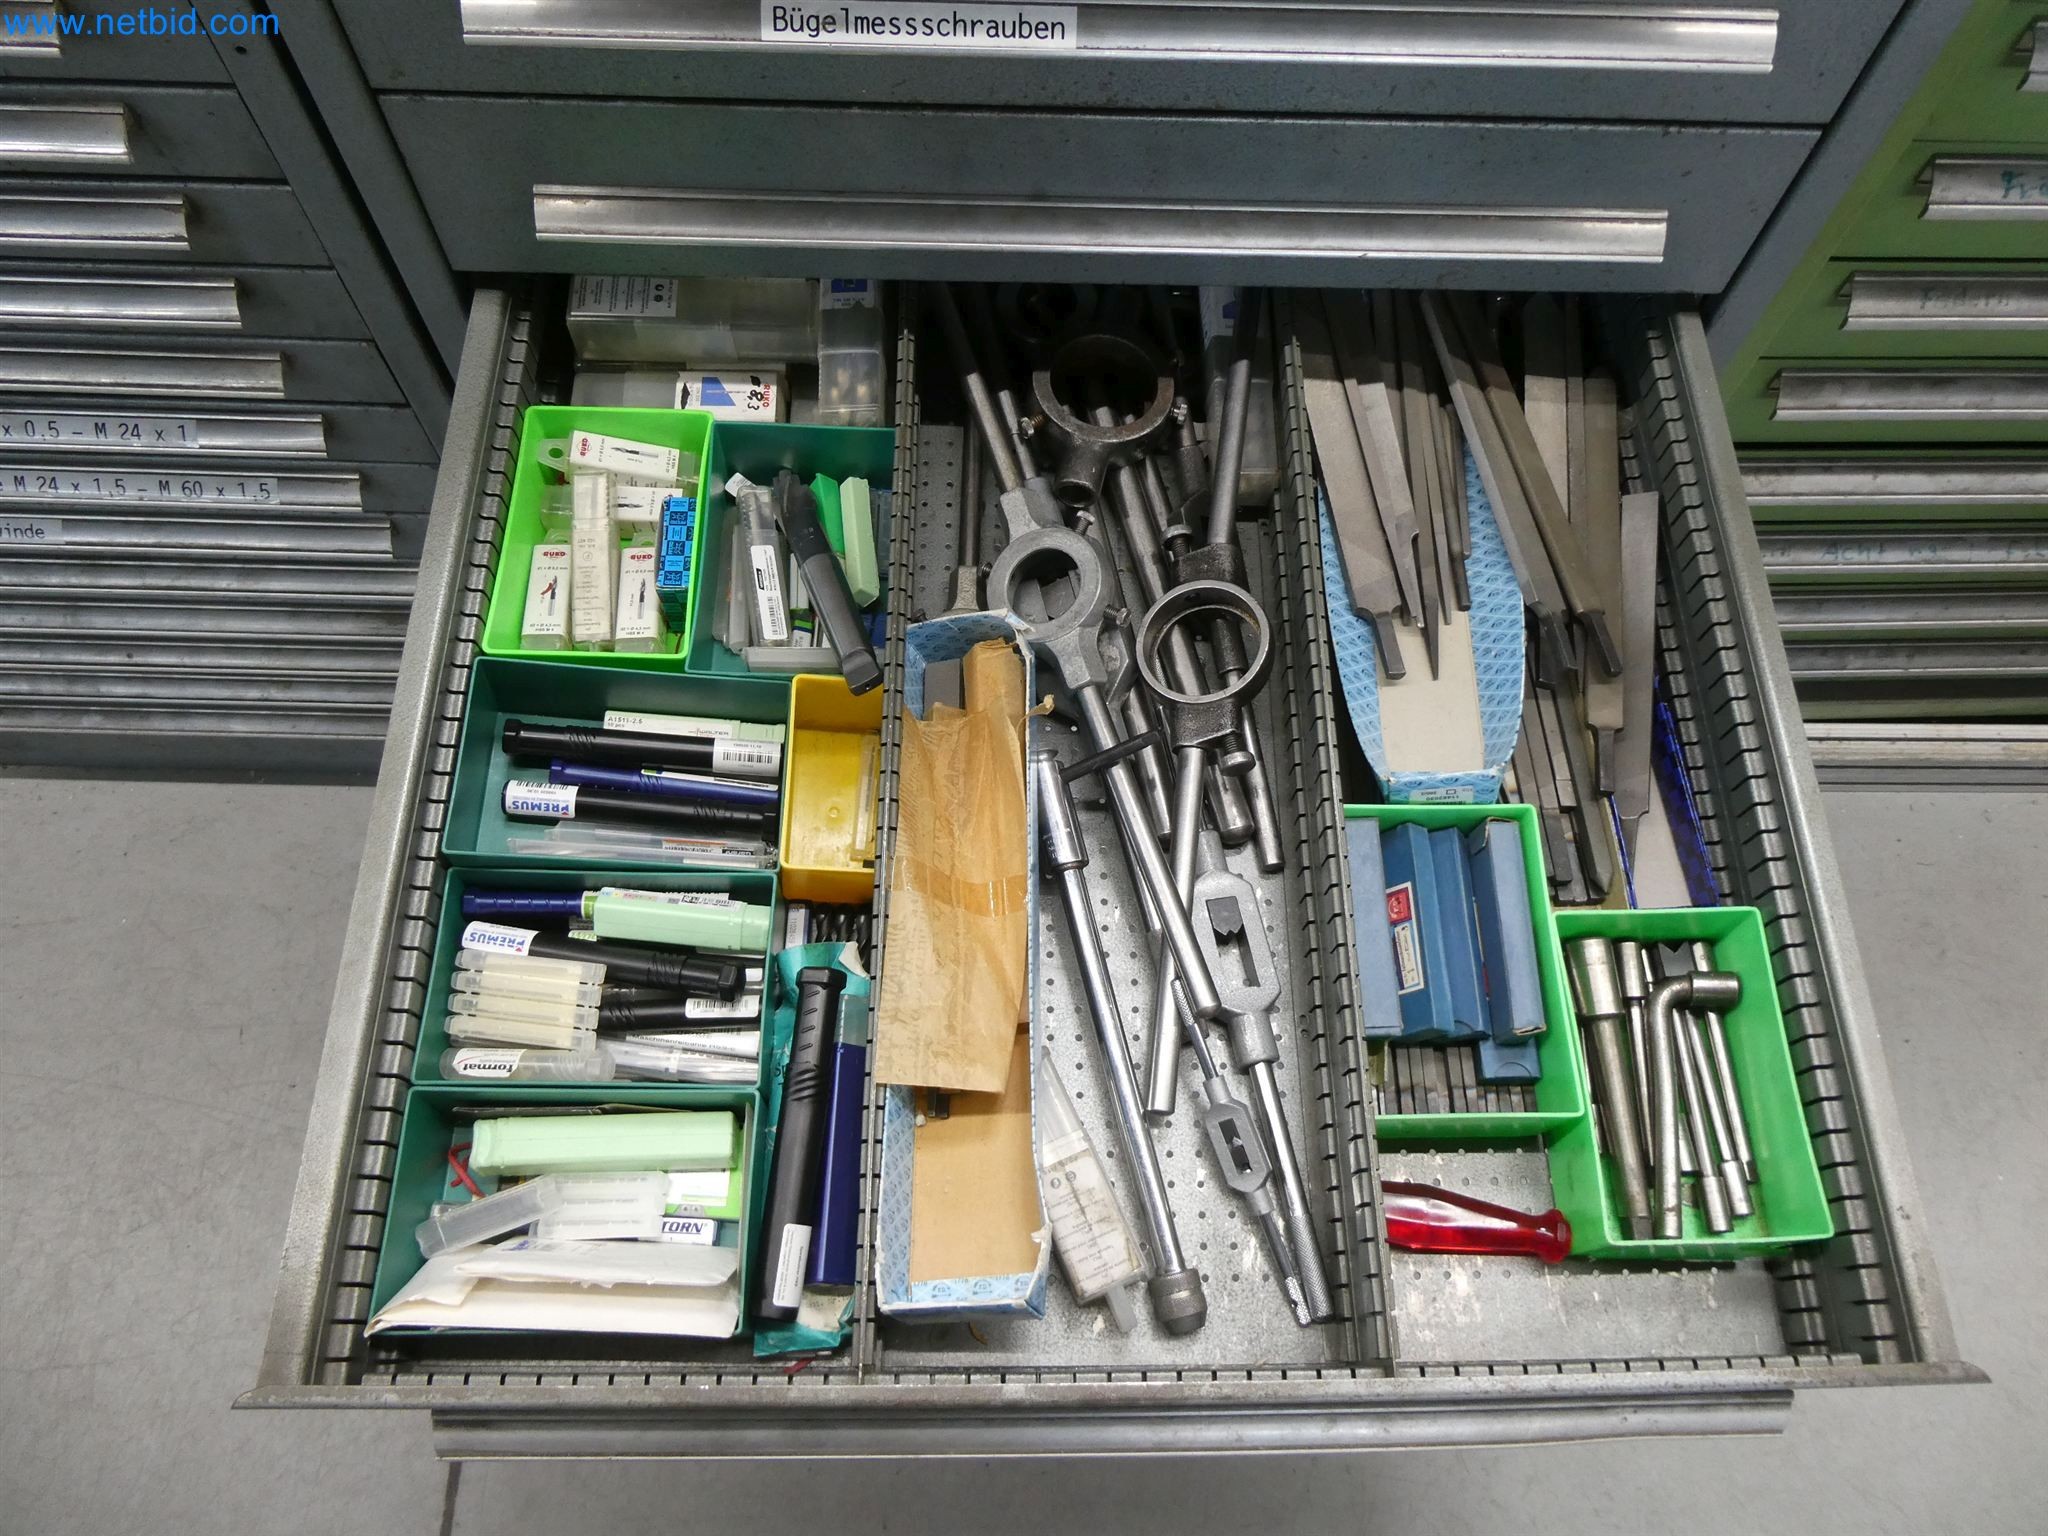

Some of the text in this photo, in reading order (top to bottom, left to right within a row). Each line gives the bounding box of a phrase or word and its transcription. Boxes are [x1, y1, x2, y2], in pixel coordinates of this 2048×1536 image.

[772, 6, 1066, 40] Bügelmessschrauben
[1, 424, 13, 437] x
[94, 422, 108, 439] M
[118, 423, 143, 440] 24
[154, 428, 166, 442] x
[177, 424, 187, 441] 1
[14, 475, 27, 492] M
[36, 476, 59, 493] 24
[71, 482, 80, 492] x
[158, 480, 171, 496] M
[181, 480, 203, 498] 60
[216, 486, 225, 497] x
[512, 800, 570, 815] PREMUS
[469, 931, 528, 951] PREMUS
[463, 1063, 513, 1073] format
